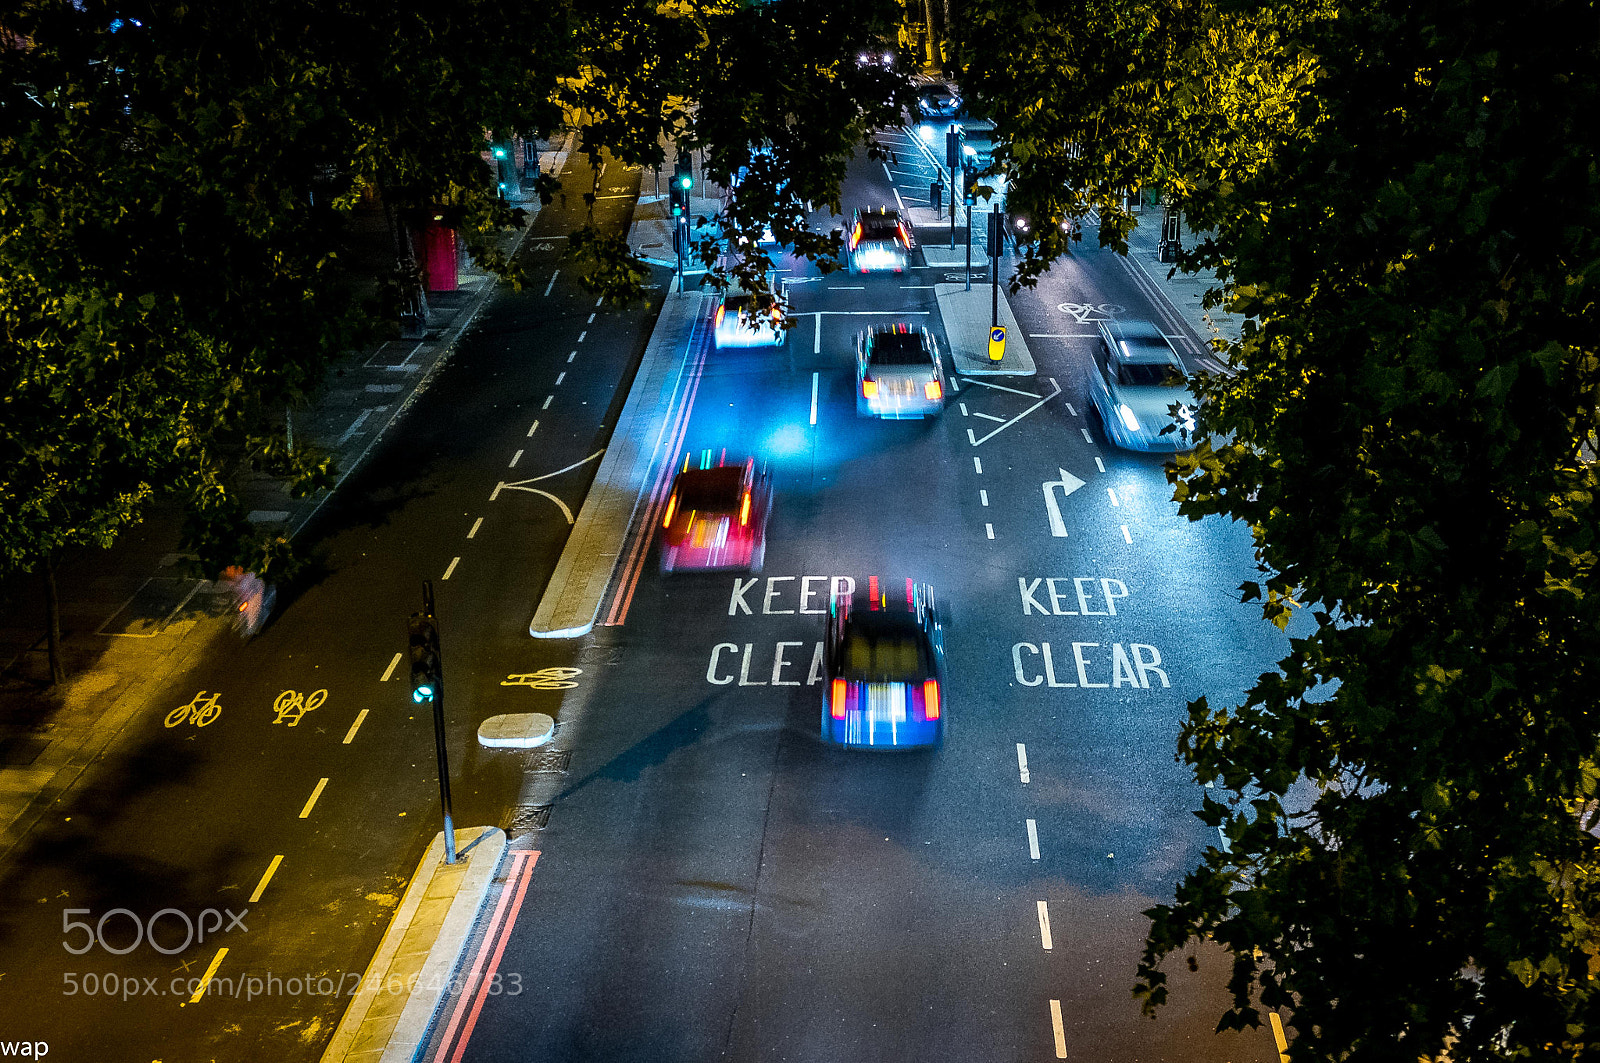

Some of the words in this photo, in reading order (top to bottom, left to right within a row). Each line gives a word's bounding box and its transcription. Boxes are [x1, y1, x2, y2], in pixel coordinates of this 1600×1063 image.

[728, 576, 856, 616] KEEP
[1018, 577, 1129, 616] KEEP
[706, 641, 825, 686] CLEA
[1011, 642, 1171, 688] CLEAR
